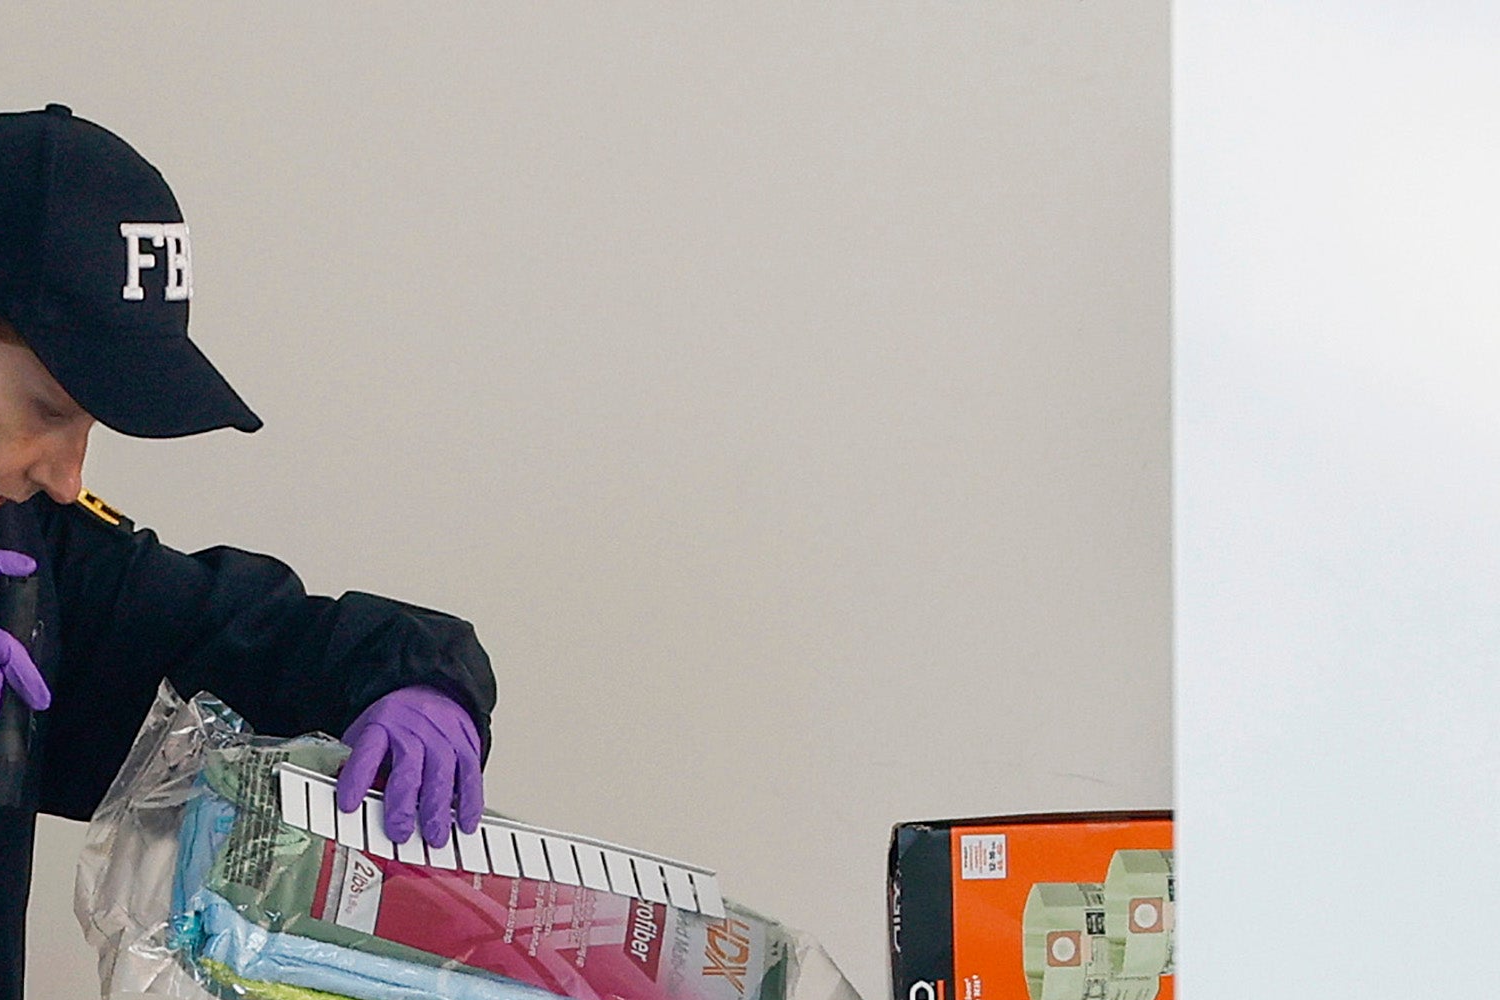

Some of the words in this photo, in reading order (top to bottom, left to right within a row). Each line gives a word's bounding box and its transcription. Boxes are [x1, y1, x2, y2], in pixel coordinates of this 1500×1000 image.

[120, 222, 193, 300] FB
[630, 900, 657, 963] rofiber
[702, 918, 750, 995] HDX
